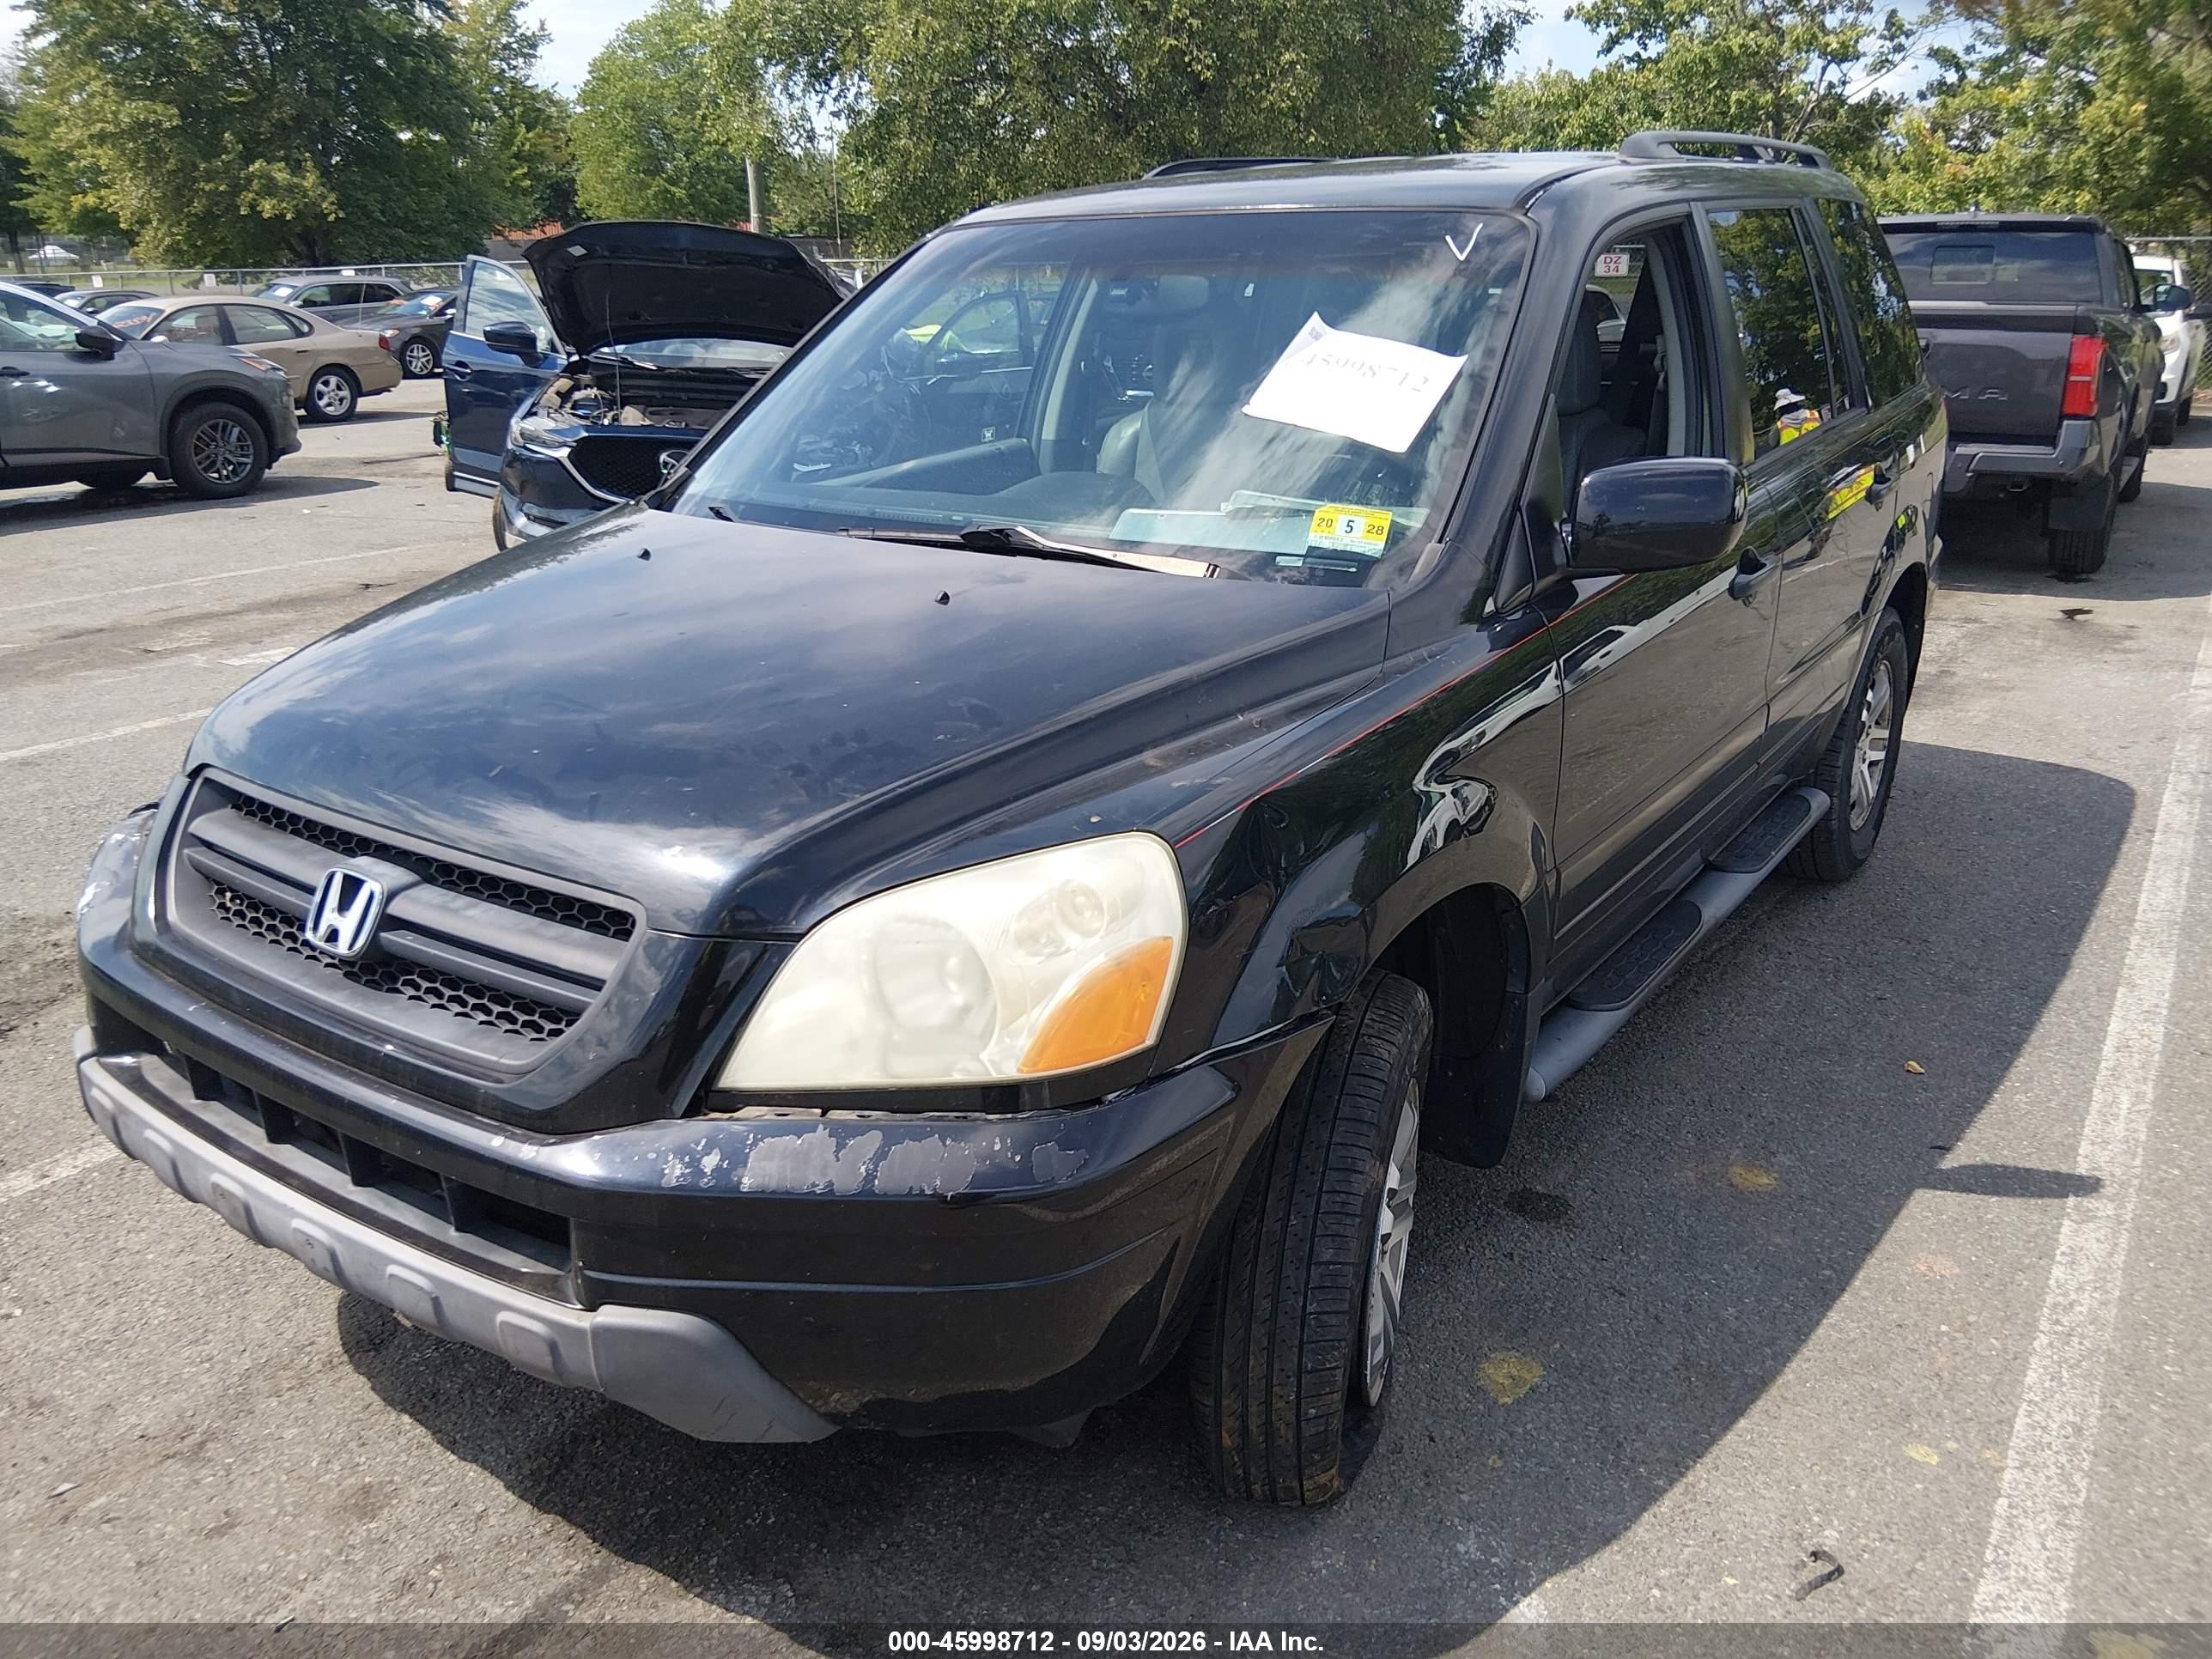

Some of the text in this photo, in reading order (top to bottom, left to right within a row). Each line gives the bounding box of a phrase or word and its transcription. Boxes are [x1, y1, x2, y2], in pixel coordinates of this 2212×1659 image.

[1603, 256, 1622, 264] DZ
[1603, 265, 1620, 274] 34
[1316, 517, 1385, 536] 20 5 28
